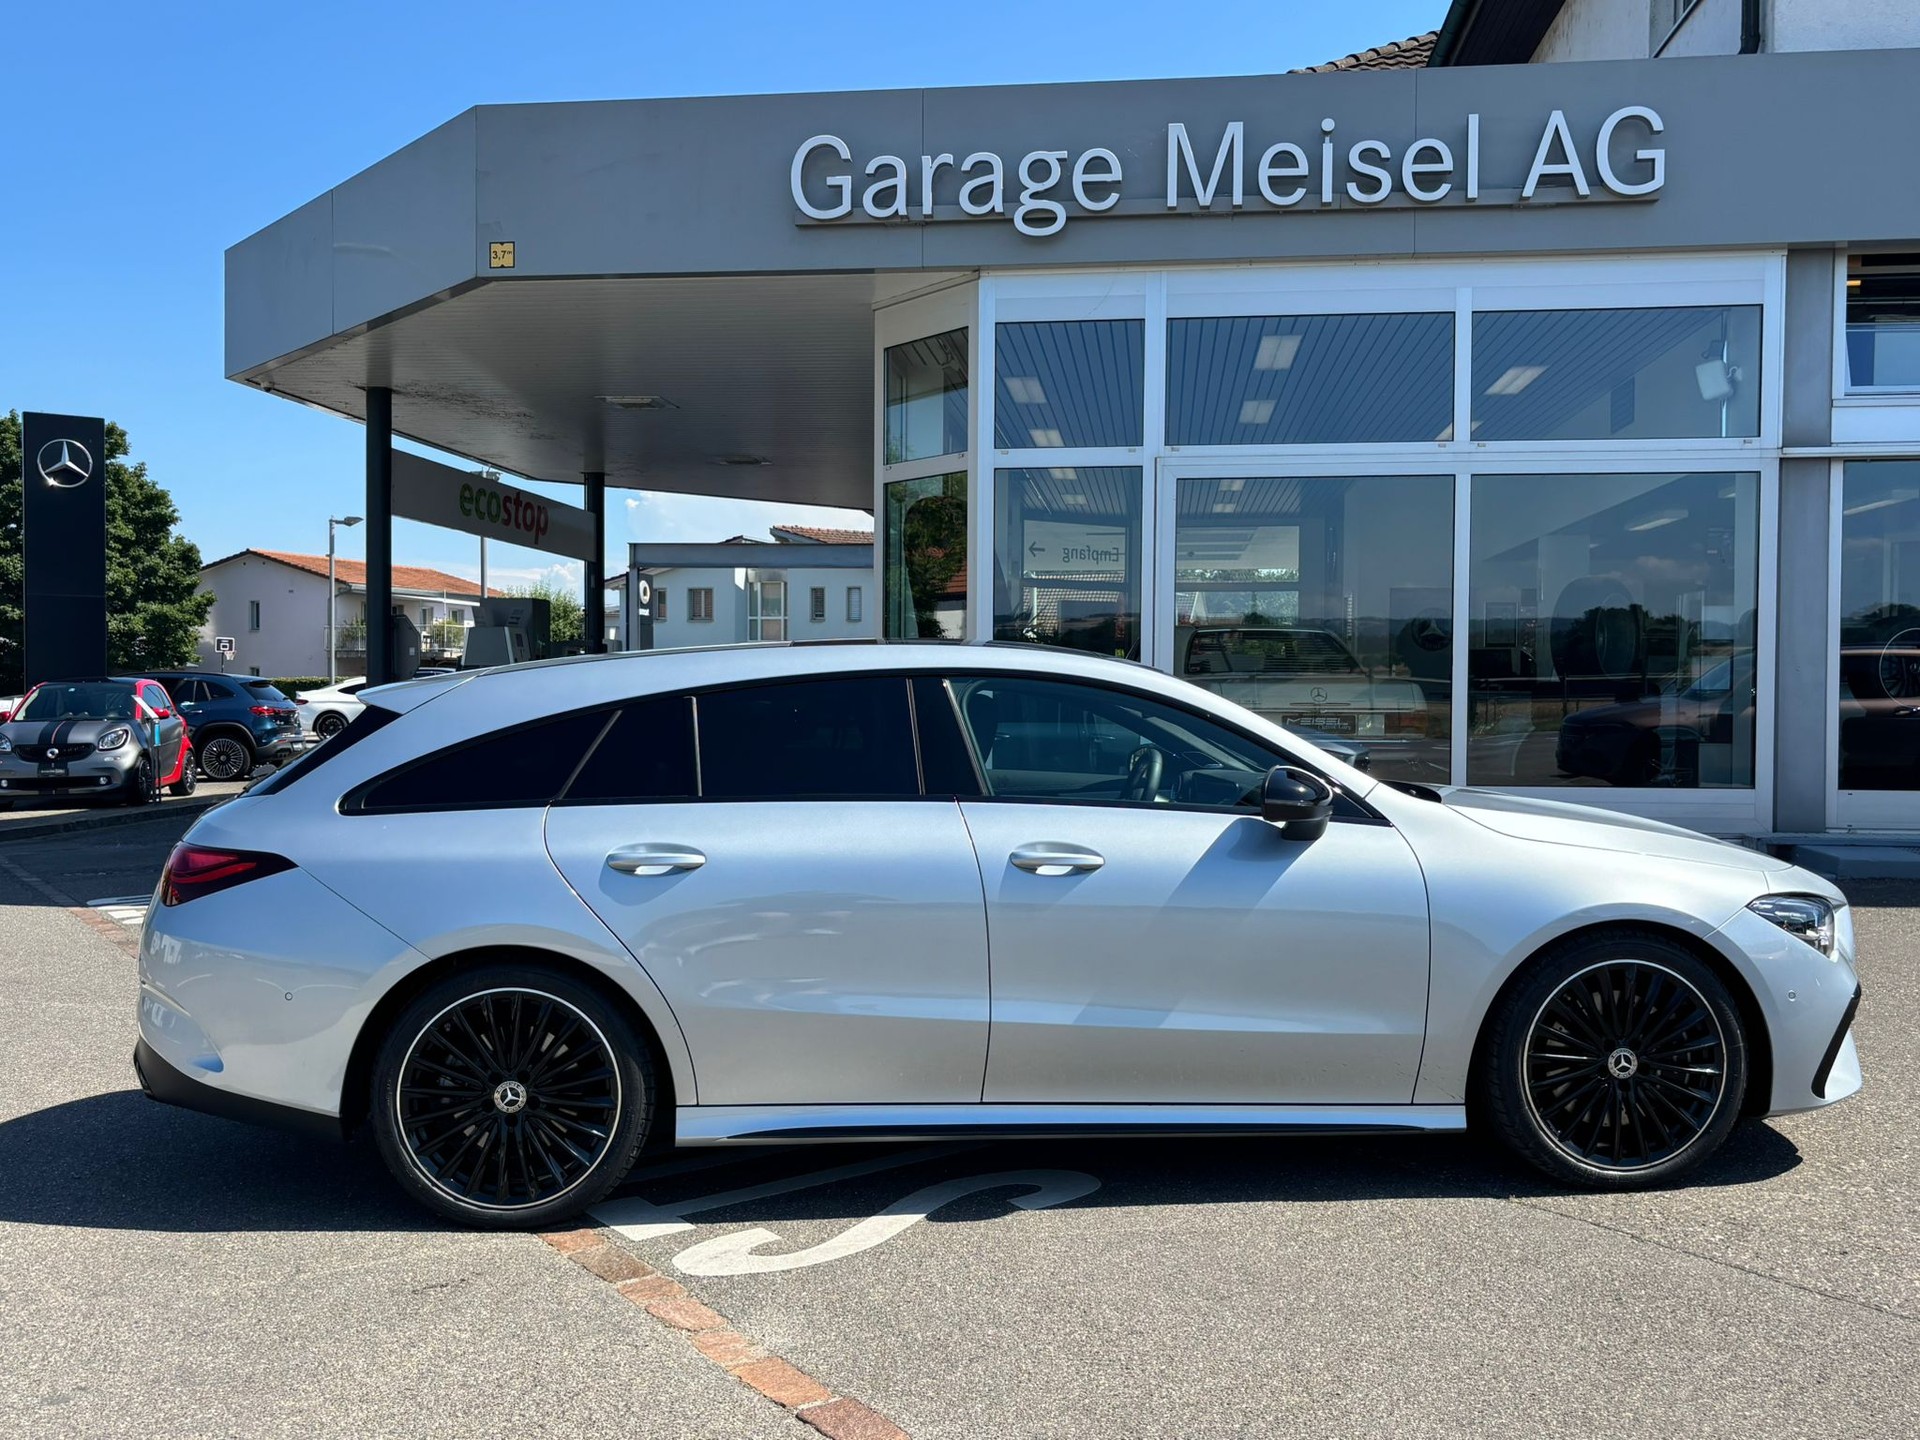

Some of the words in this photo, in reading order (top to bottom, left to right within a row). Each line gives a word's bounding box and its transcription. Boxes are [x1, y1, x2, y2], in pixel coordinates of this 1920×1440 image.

[790, 135, 1122, 237] Garage
[1166, 114, 1480, 207] Meisel
[1522, 106, 1667, 199] AG
[459, 483, 549, 545] ecostop
